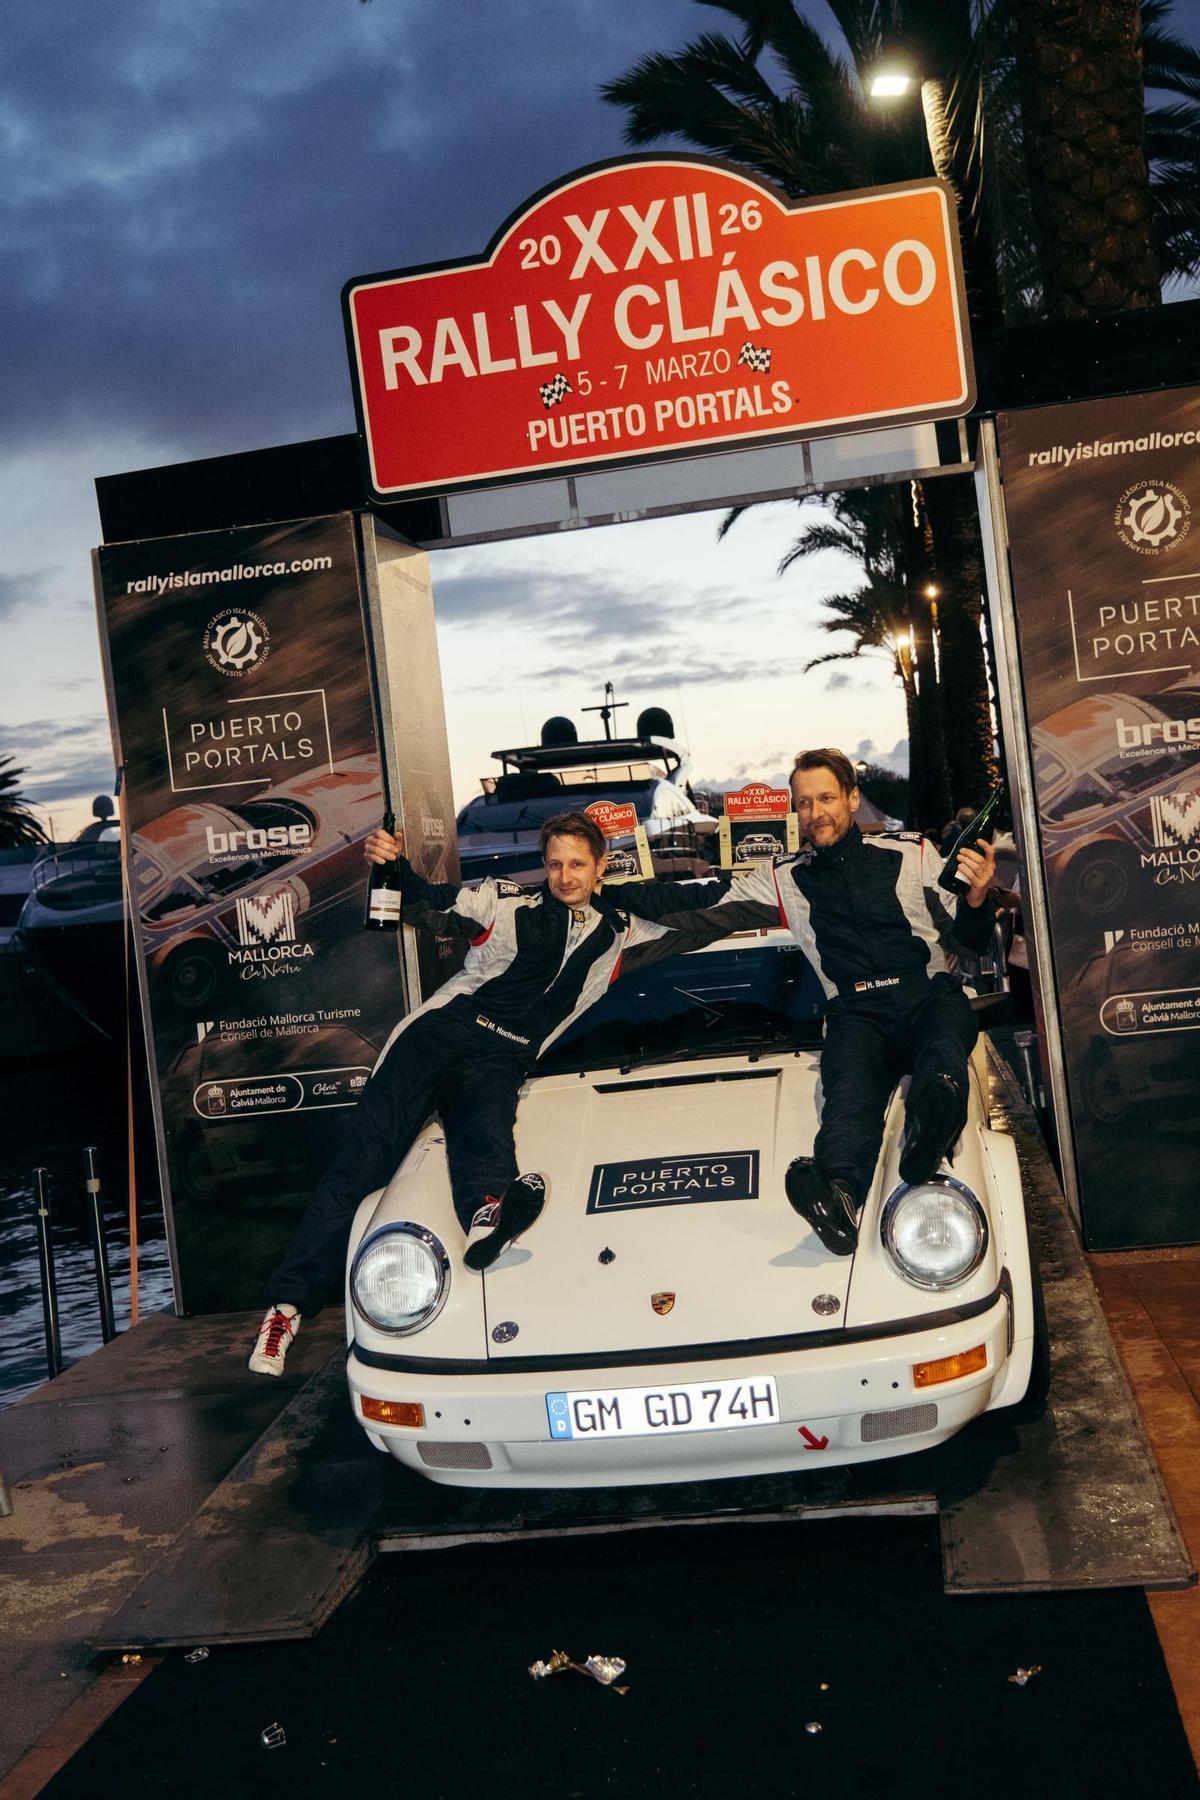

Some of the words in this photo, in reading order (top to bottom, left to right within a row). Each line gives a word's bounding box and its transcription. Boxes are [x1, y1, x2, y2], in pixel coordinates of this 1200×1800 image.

[518, 234, 562, 270] 20
[563, 192, 713, 280] XXII
[718, 200, 763, 235] 26
[378, 293, 592, 391] RALLY
[613, 238, 937, 350] CLÁSICO
[576, 371, 592, 396] 5
[615, 365, 628, 390] 7
[645, 348, 731, 385] MARZO
[527, 403, 646, 451] PUERTO
[656, 381, 793, 432] PORTALS
[1114, 503, 1123, 526] RALLY
[1119, 481, 1148, 504] CLÁSICO
[1148, 479, 1164, 487] ISLA
[1164, 482, 1191, 516] MALLORCA
[1117, 529, 1159, 555] SUSTAINABLE
[126, 556, 332, 595] rallyislamallorca.com
[203, 629, 211, 650] RALLY
[232, 607, 247, 615] ISLA
[247, 610, 271, 642] MALLORCA
[206, 654, 243, 677] SUSTAINABLE
[190, 711, 302, 743] PUERTO
[185, 738, 314, 771] PORTALS
[1120, 748, 1166, 759] Excellence
[1168, 745, 1176, 753] in
[727, 796, 752, 805] RALLY
[748, 788, 766, 796] XXII
[593, 805, 610, 816] XXII
[205, 823, 311, 854] brose
[209, 854, 250, 864] Excellence
[260, 846, 312, 858] Mechatronics
[500, 884, 519, 894] OMP
[1130, 923, 1185, 940] Fundació
[228, 943, 314, 965] MALLORCA
[1131, 937, 1174, 953] Consell
[1177, 937, 1192, 949] de
[867, 981, 875, 989] H.
[875, 977, 900, 988] Becker
[1141, 1000, 1193, 1014] Ajuntament
[219, 1016, 267, 1031] Fundació
[270, 1012, 315, 1025] Mallorca
[317, 1008, 361, 1020] Turisme
[487, 1021, 496, 1031] M.
[1143, 1012, 1170, 1023] Calvià
[220, 1028, 257, 1042] Consell
[260, 1027, 273, 1038] de
[275, 1023, 319, 1036] Mallorca
[229, 1086, 275, 1098] Ajuntament
[276, 1084, 287, 1093] de
[230, 1097, 254, 1108] Calvià
[255, 1095, 287, 1106] Mallorca
[622, 1164, 728, 1183] PUERTO
[613, 1175, 736, 1198] PORTALS
[572, 1396, 623, 1432] GM
[644, 1391, 693, 1428] GD
[701, 1383, 775, 1423] 74H
[556, 1420, 566, 1432] D
